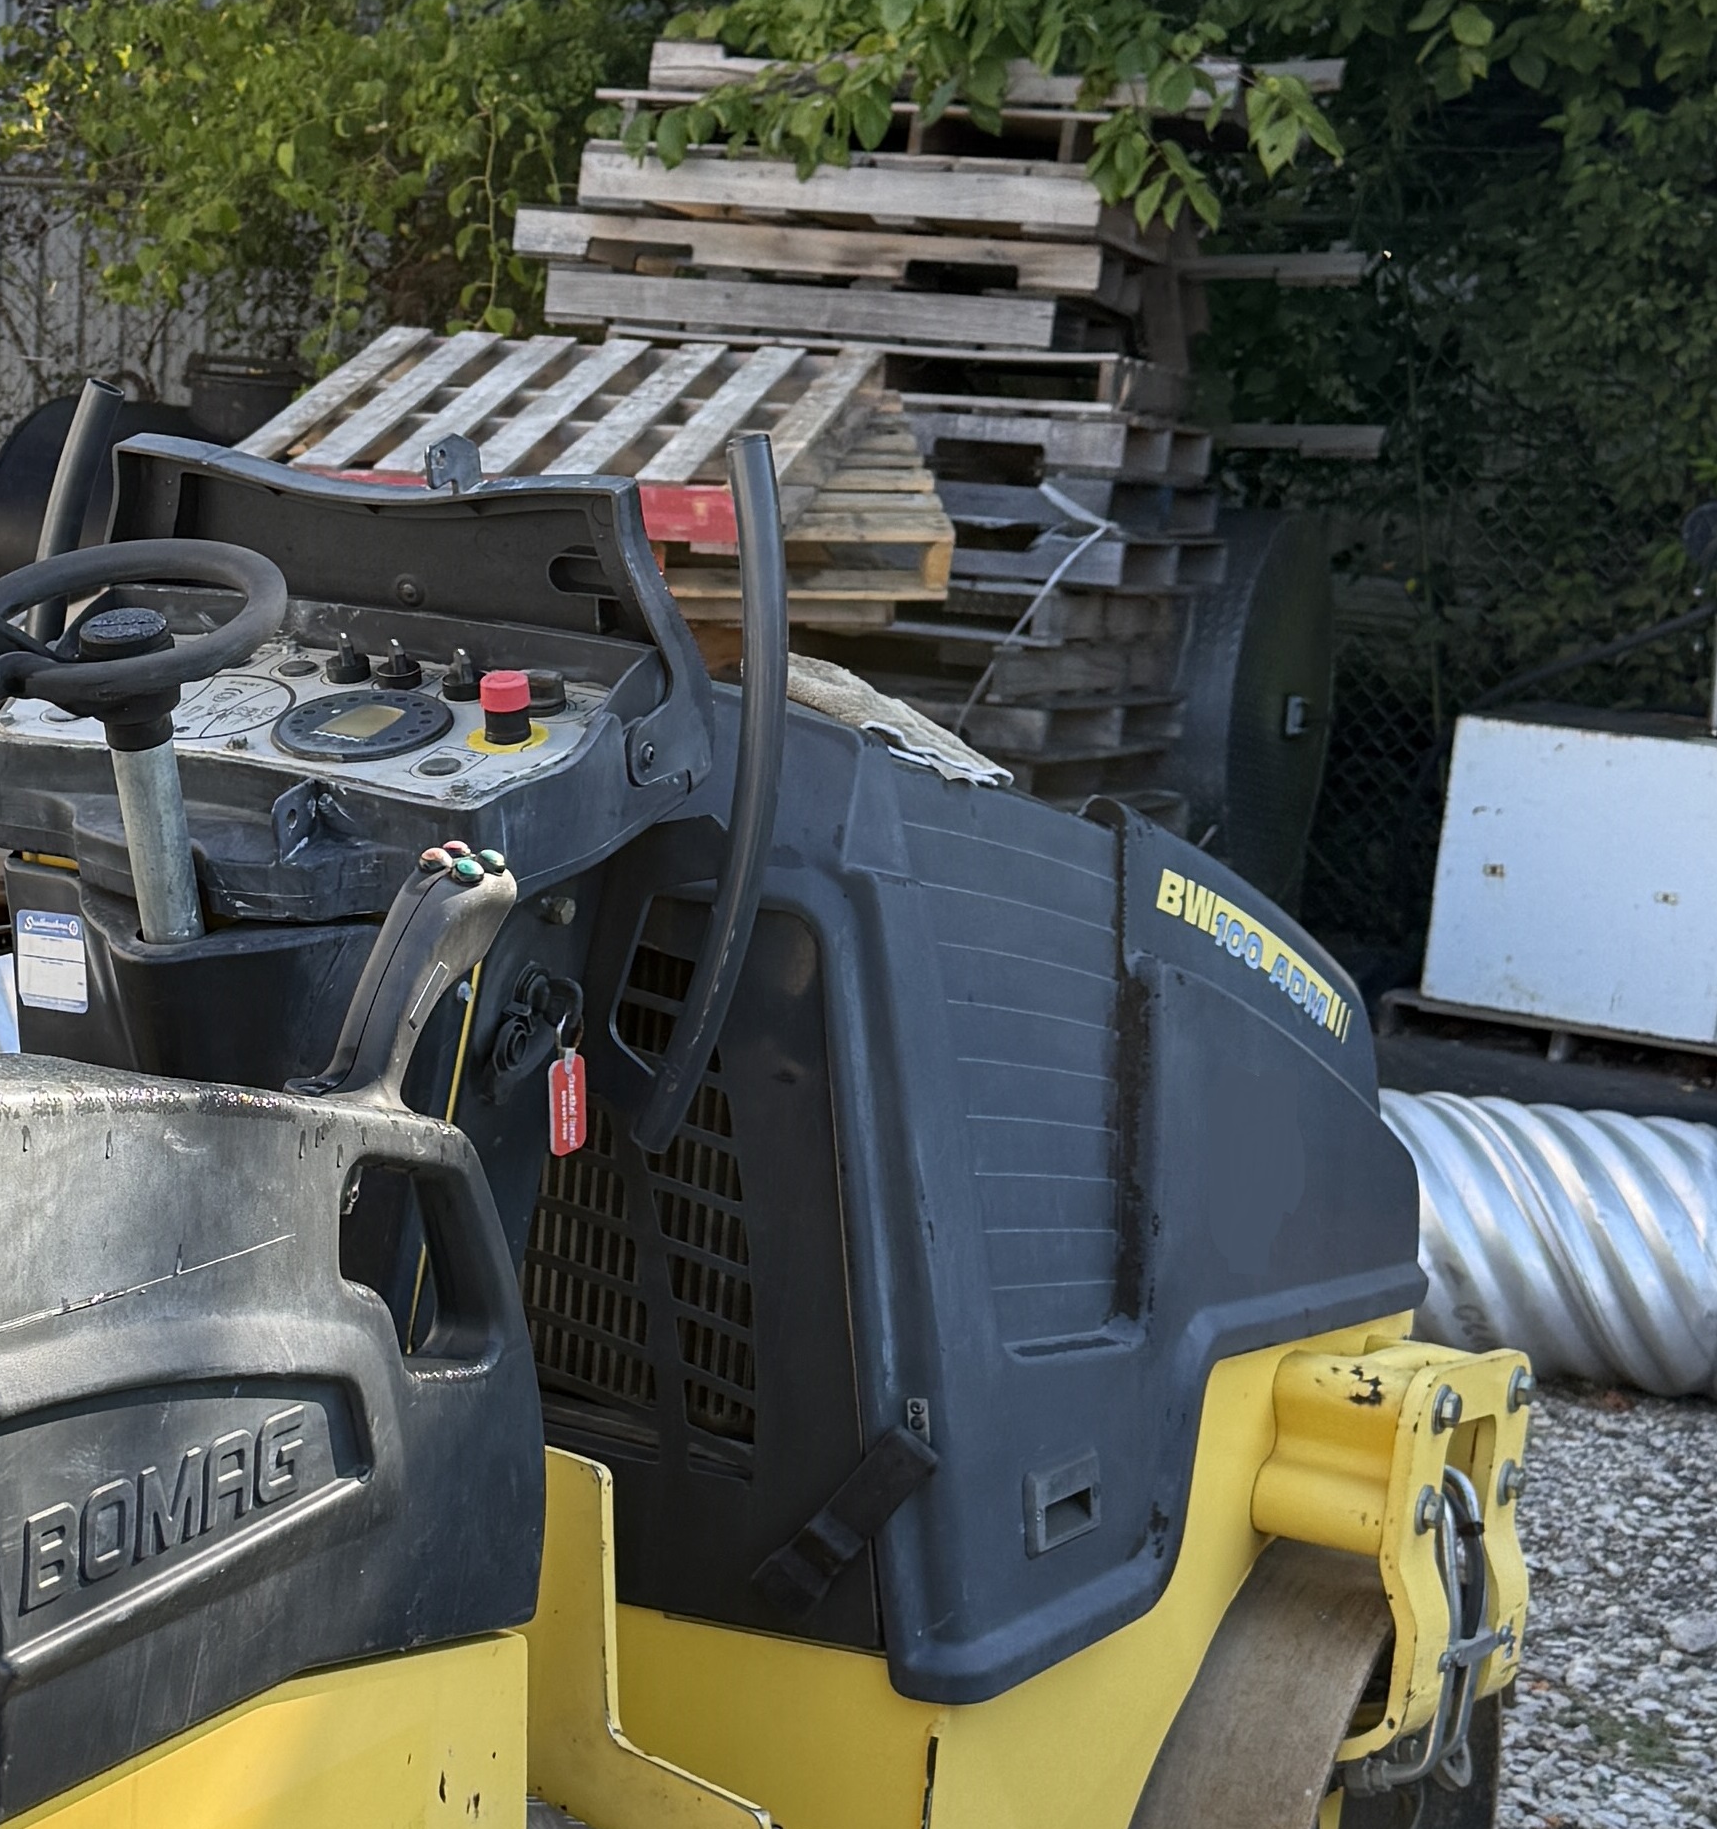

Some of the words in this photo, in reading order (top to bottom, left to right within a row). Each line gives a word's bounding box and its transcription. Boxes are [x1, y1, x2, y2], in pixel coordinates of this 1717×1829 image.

[1156, 868, 1264, 970] BW100
[1269, 954, 1329, 1027] ADM
[18, 1403, 305, 1616] BOMAG
